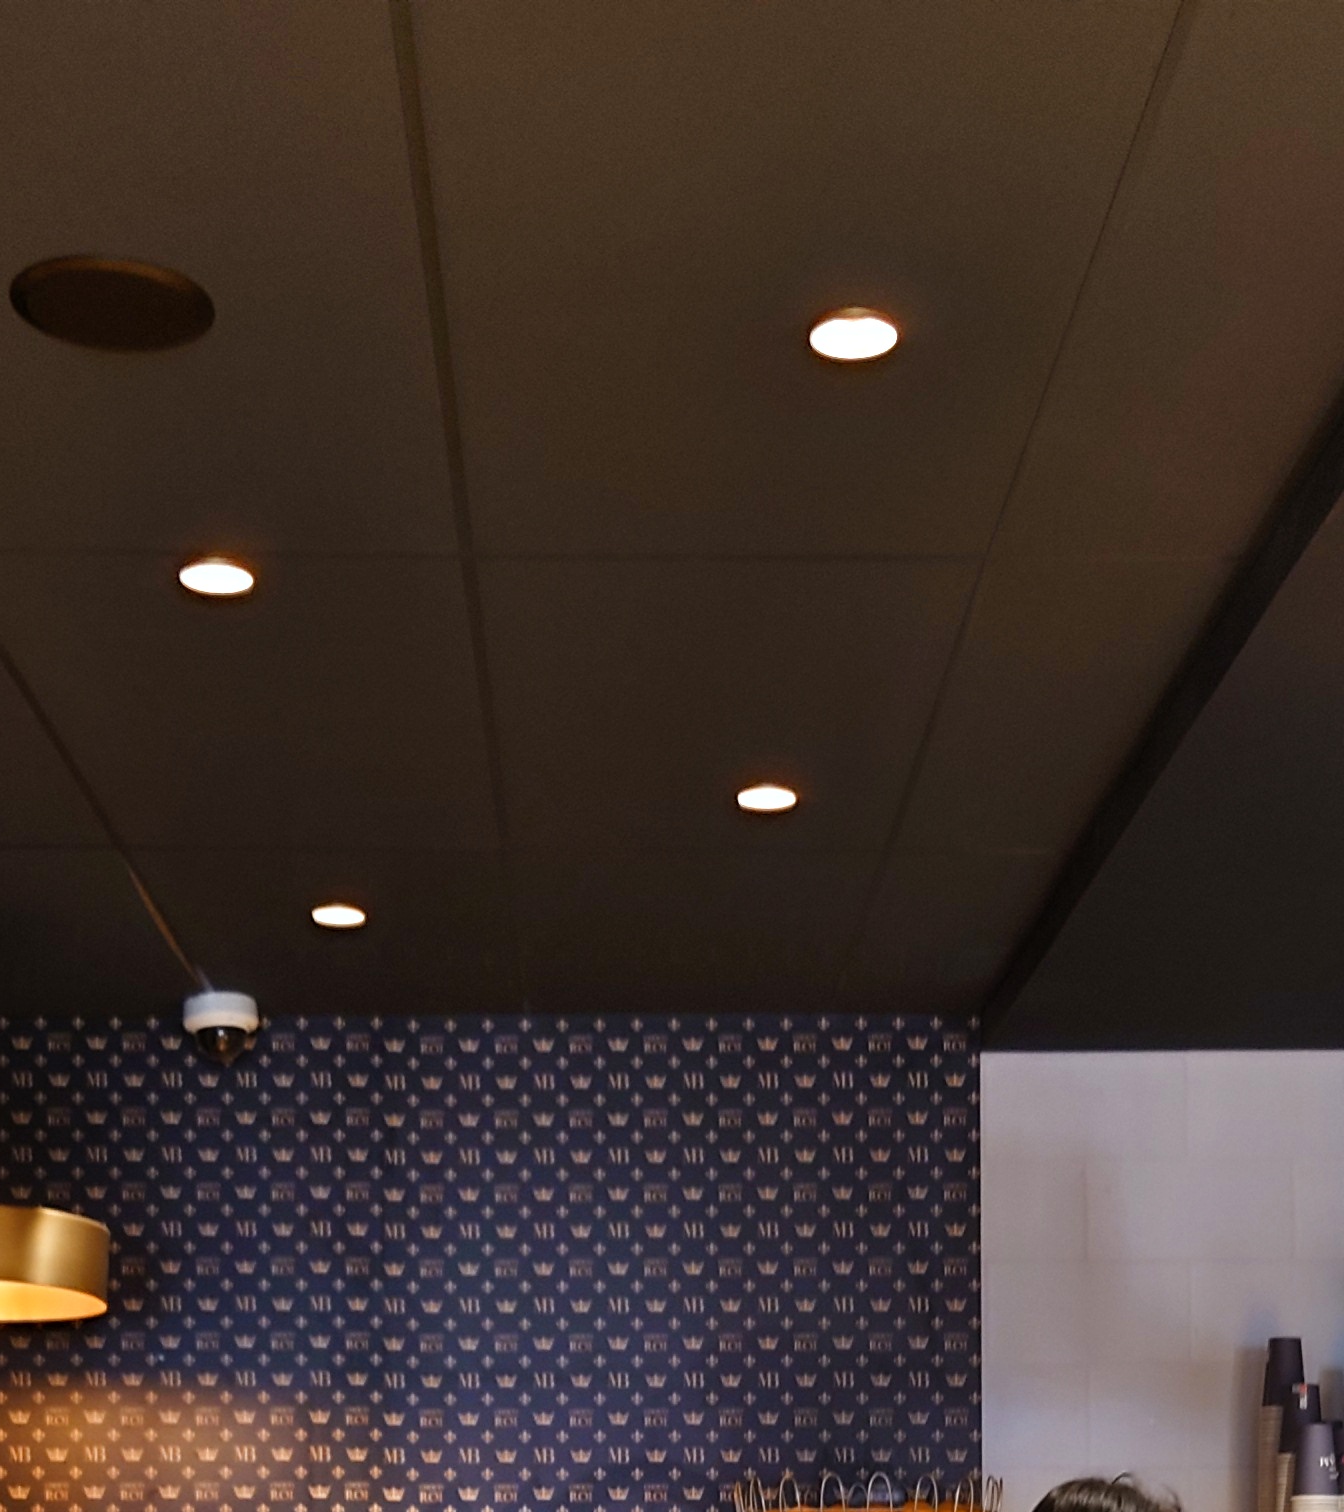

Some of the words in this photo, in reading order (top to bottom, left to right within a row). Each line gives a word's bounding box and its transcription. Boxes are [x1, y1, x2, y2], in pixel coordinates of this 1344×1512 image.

[12, 1071, 34, 1088] MB
[161, 1071, 183, 1088] MB
[534, 1073, 556, 1090] MB
[236, 1146, 258, 1163] MB
[683, 1147, 705, 1164] MB
[459, 1223, 481, 1240] MB
[608, 1222, 630, 1239] MB
[310, 1295, 332, 1312] MB
[683, 1296, 705, 1313] MB
[235, 1370, 257, 1387] MB
[459, 1372, 481, 1389] MB
[833, 1371, 855, 1388] MB
[10, 1446, 32, 1463] MB
[160, 1445, 182, 1462] MB
[310, 1445, 332, 1462] MB
